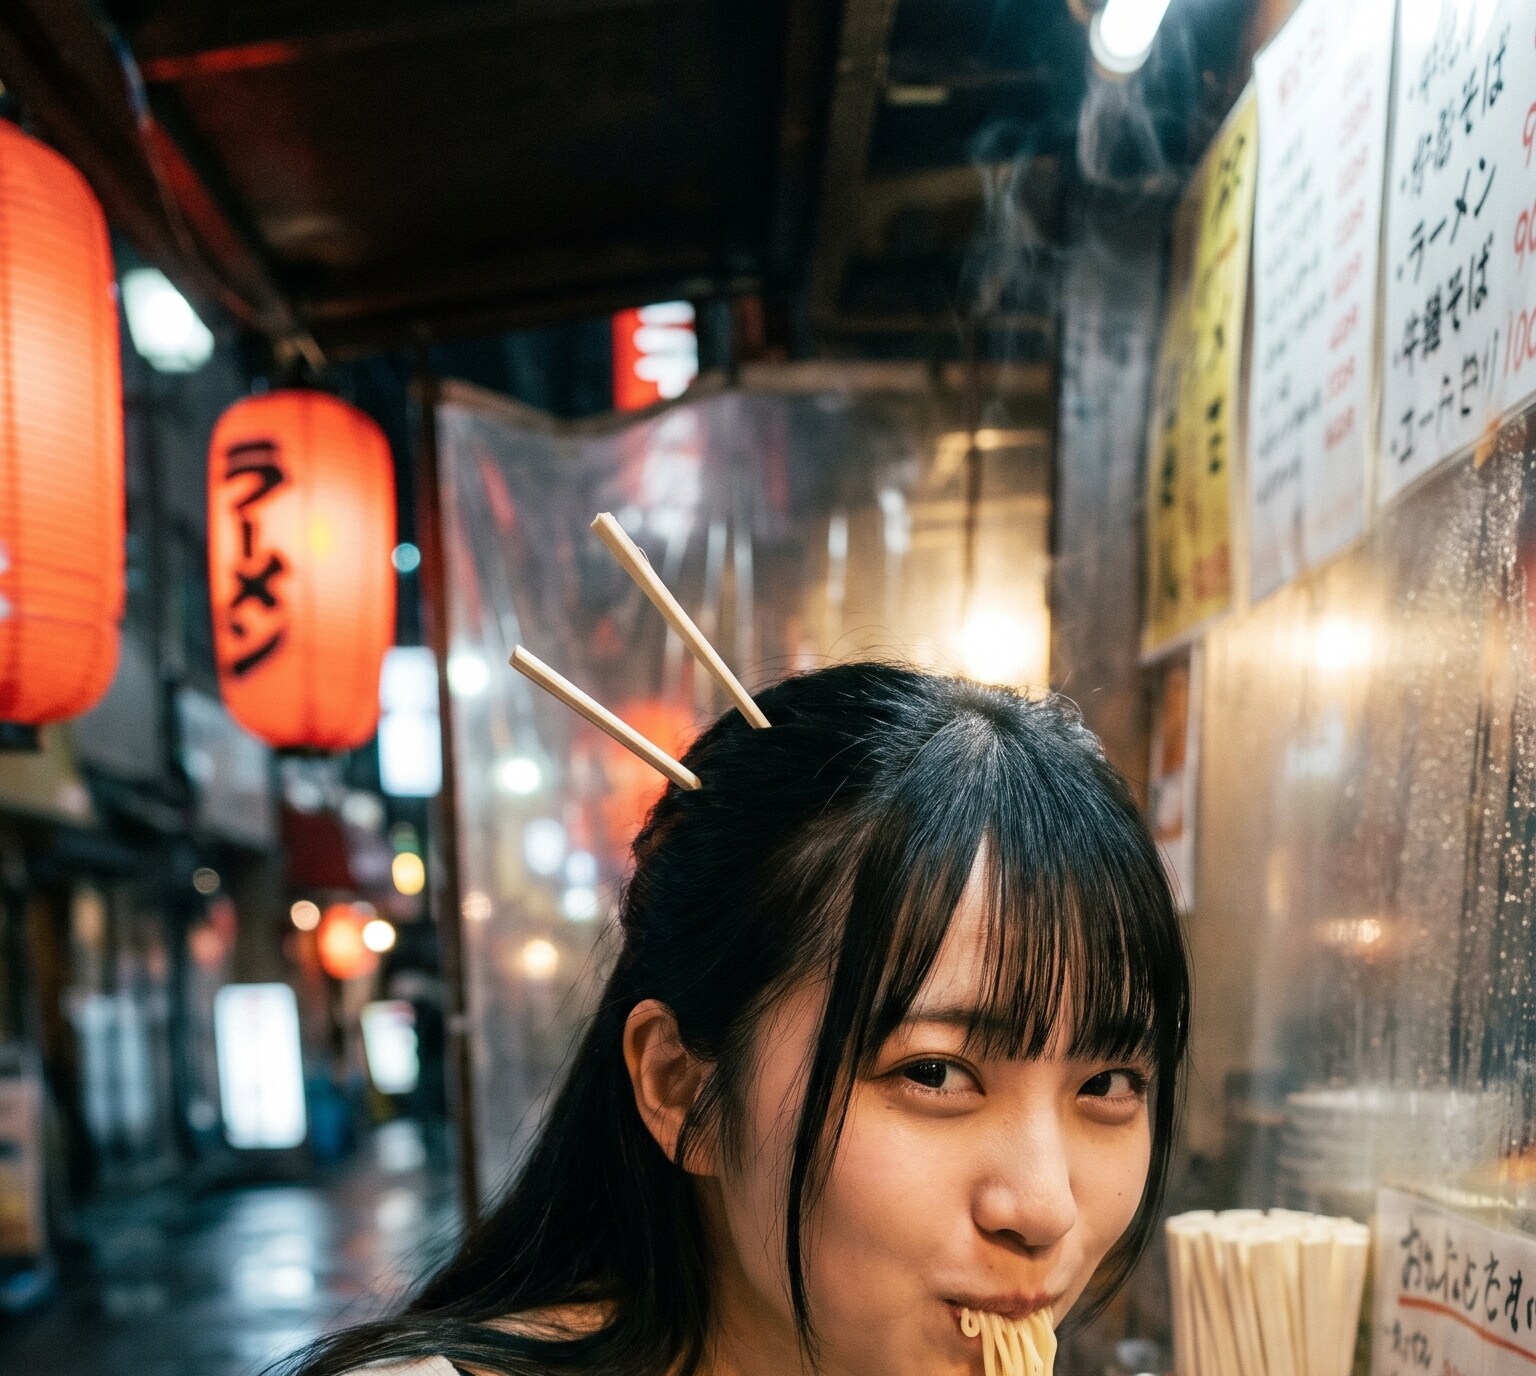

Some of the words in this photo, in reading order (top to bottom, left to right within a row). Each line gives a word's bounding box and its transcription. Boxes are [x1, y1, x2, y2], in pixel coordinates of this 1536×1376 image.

[1408, 163, 1497, 284] ラーメン
[225, 439, 284, 678] ラーメン
